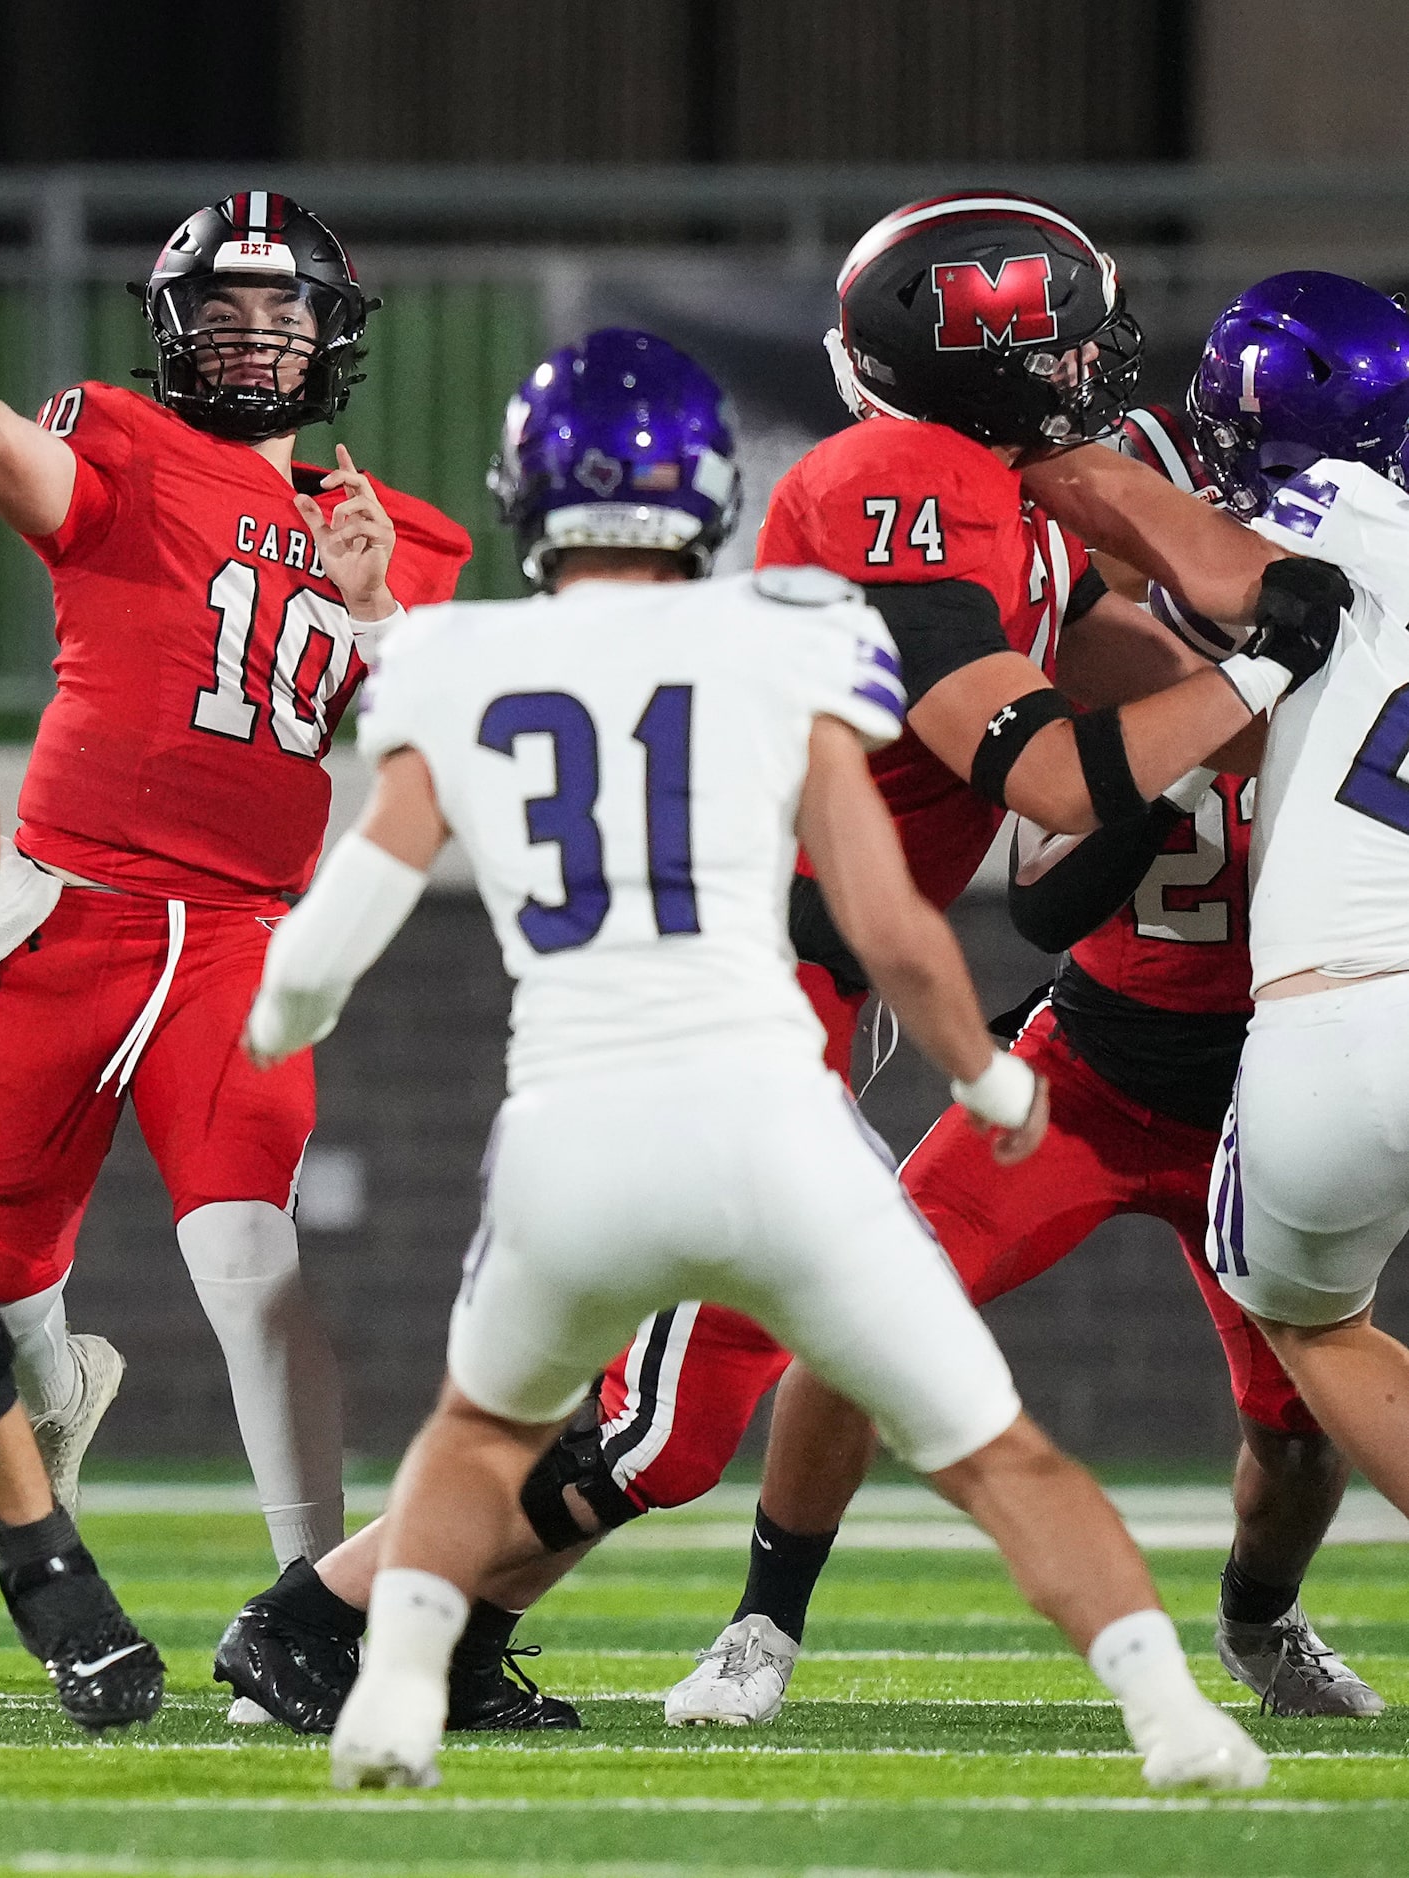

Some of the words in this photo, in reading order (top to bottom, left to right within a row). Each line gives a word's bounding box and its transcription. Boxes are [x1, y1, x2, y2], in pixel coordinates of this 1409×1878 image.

[931, 253, 1058, 351] M
[1239, 344, 1261, 413] 1
[237, 513, 327, 579] CAR
[864, 497, 944, 565] 74
[190, 556, 356, 761] 10
[477, 684, 701, 955] 31
